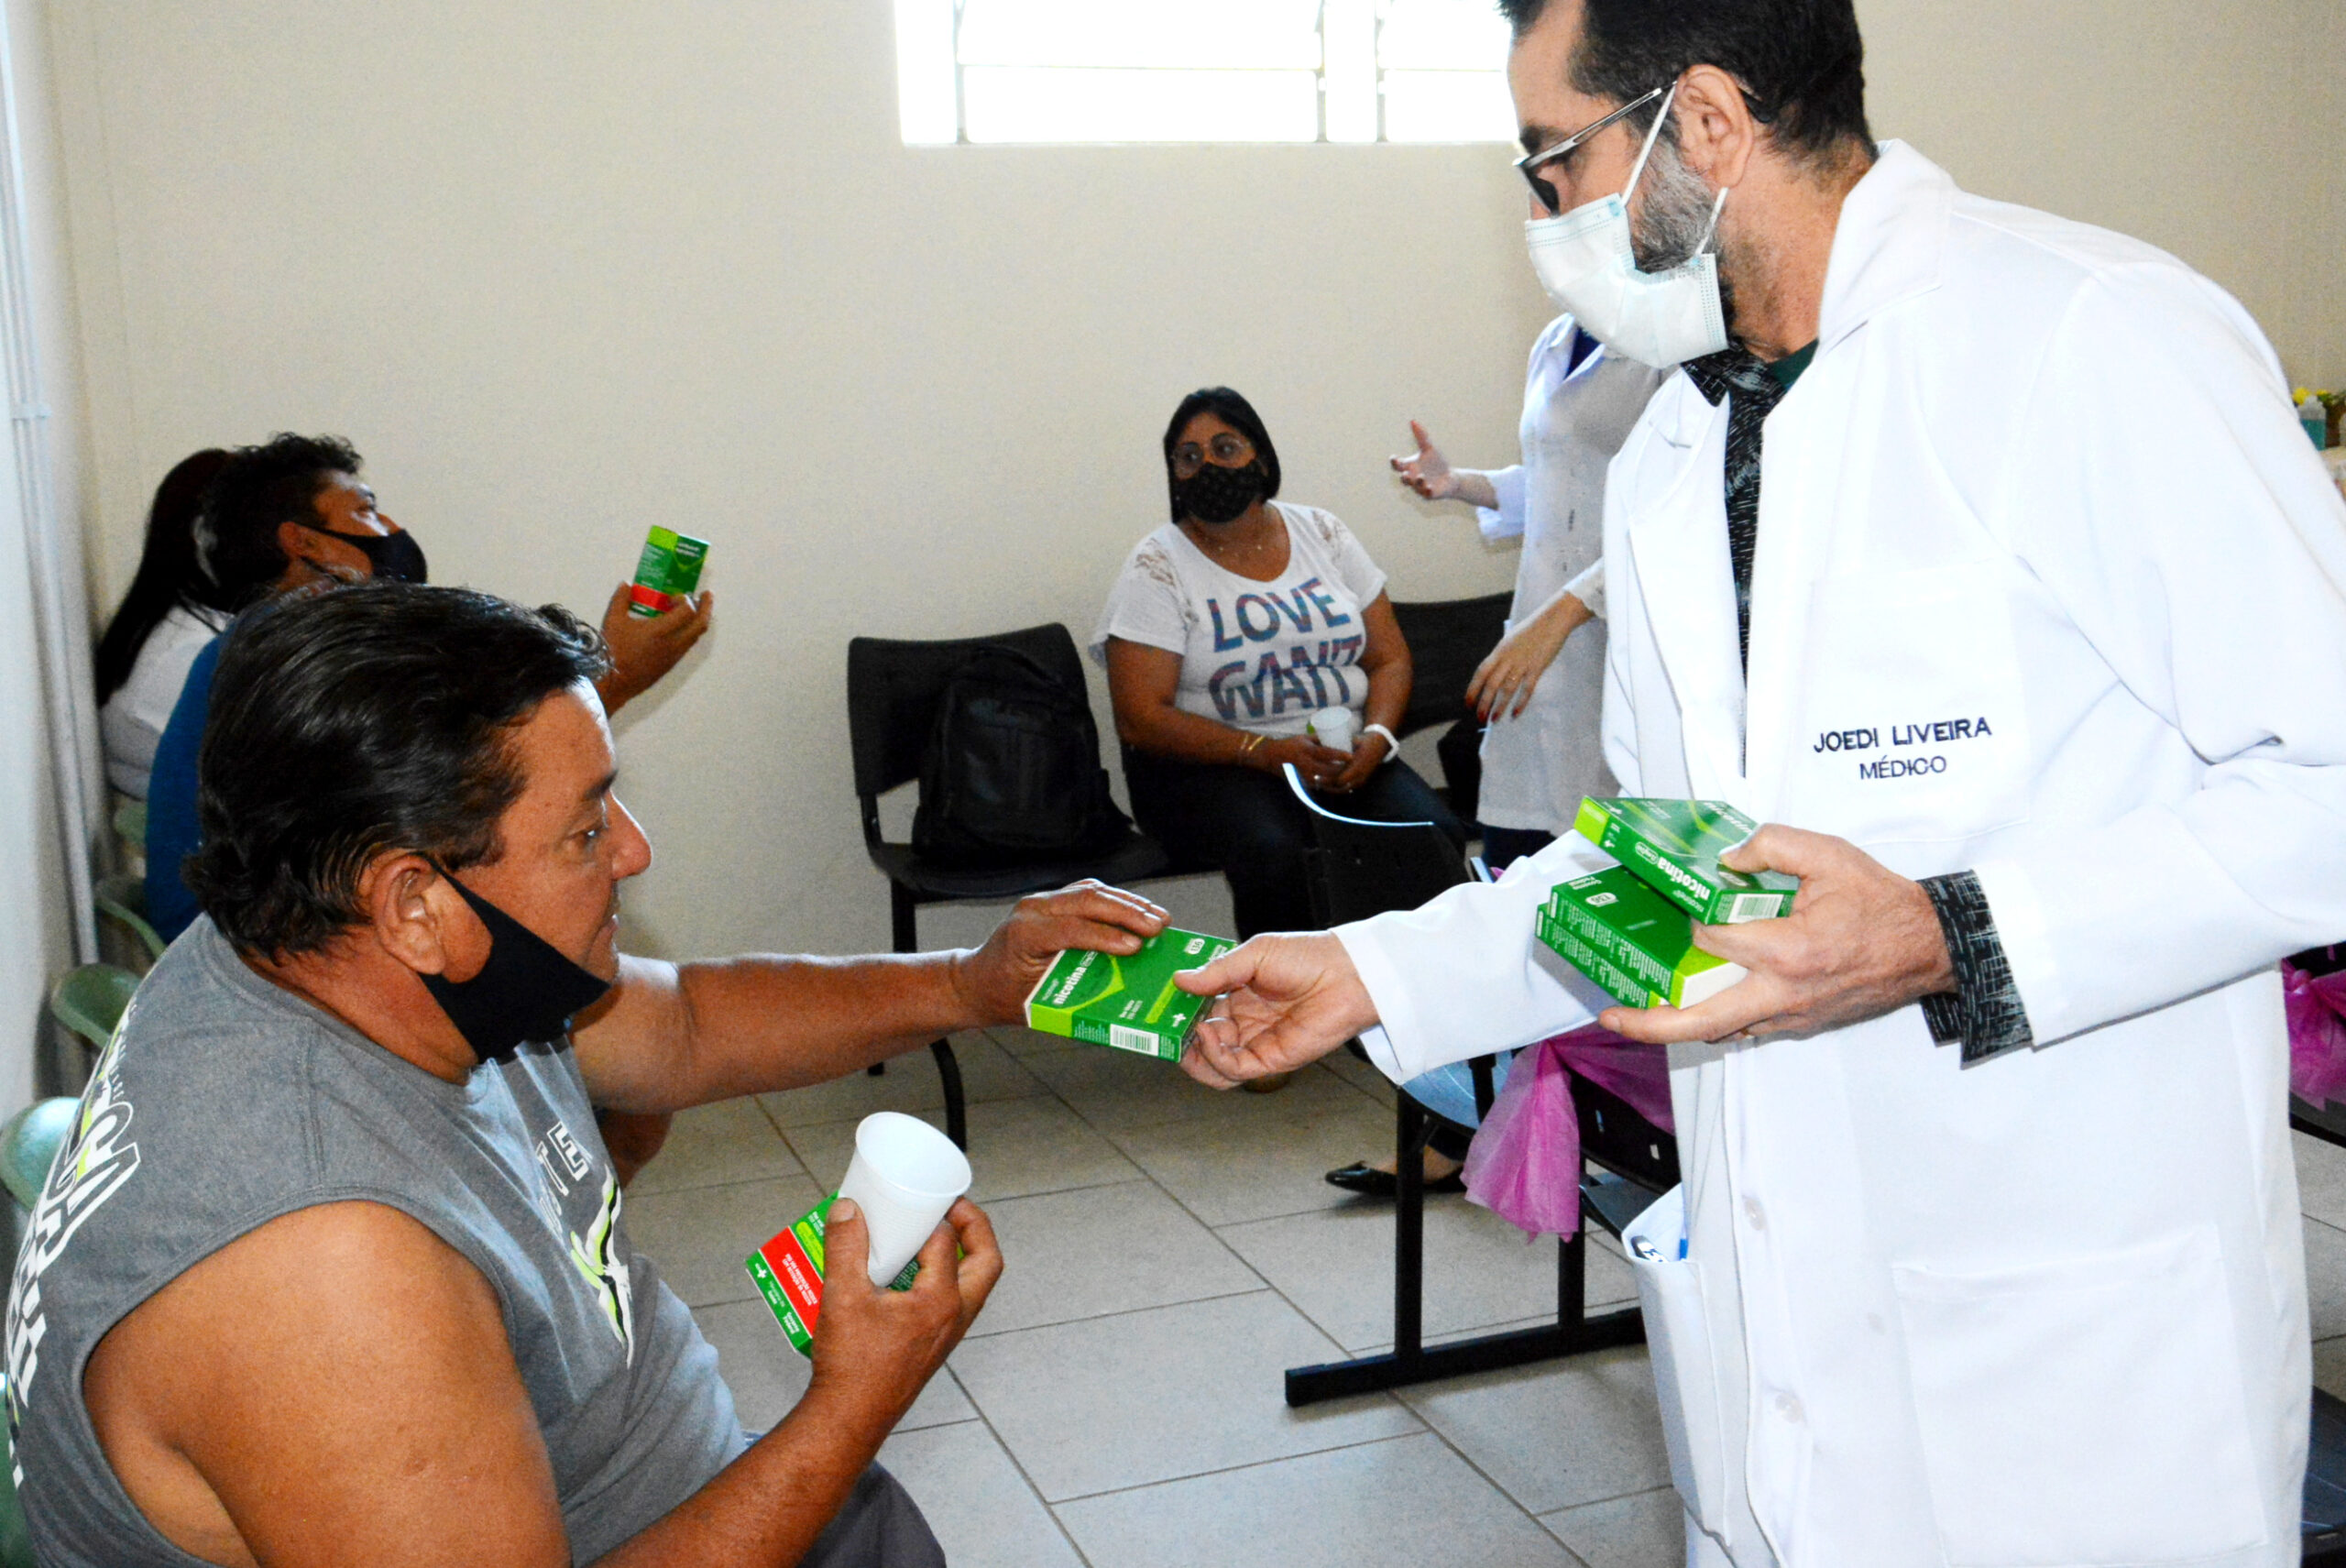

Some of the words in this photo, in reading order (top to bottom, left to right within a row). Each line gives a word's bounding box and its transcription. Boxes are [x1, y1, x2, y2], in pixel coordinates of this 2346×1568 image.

[1206, 576, 1352, 653] LOVE
[1814, 728, 1880, 753] JOEDI
[1891, 717, 1993, 746] LIVEIRA
[1859, 754, 1947, 780] MÉDICO
[1657, 856, 1711, 901] nicotina
[1053, 966, 1088, 1004] nicotina
